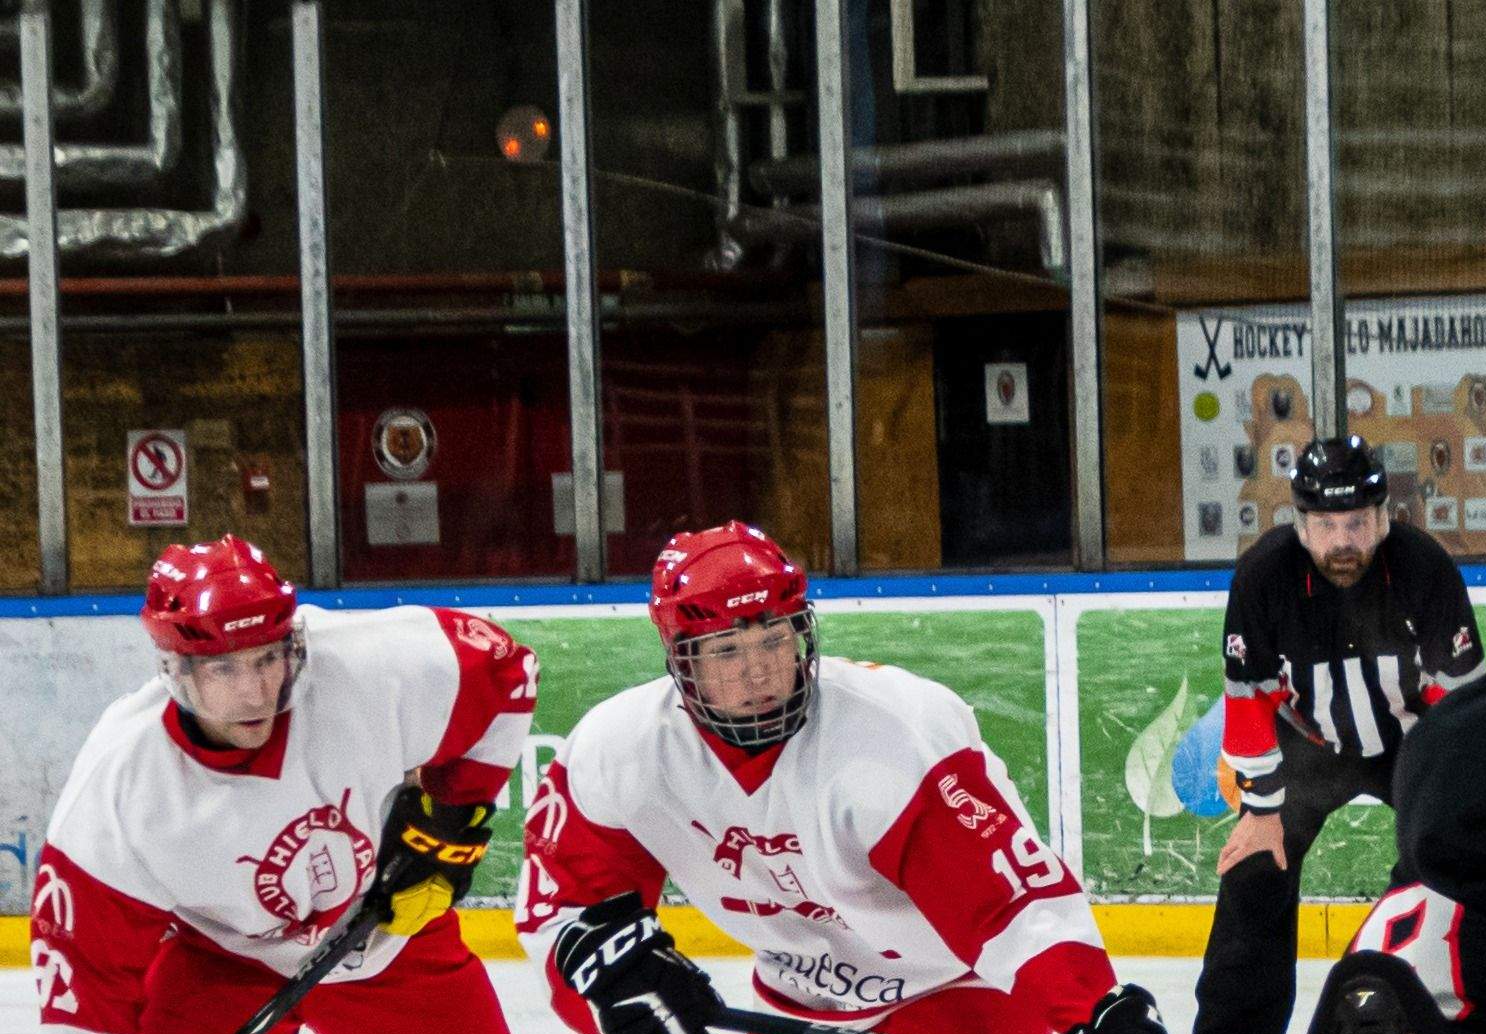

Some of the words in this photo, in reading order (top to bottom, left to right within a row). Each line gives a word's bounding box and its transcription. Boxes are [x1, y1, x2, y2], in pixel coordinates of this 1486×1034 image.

[1233, 322, 1307, 359] HOCKEY
[726, 589, 769, 608] CCM
[224, 614, 266, 633] CCM
[992, 826, 1065, 903] 19
[571, 914, 662, 995] CCM
